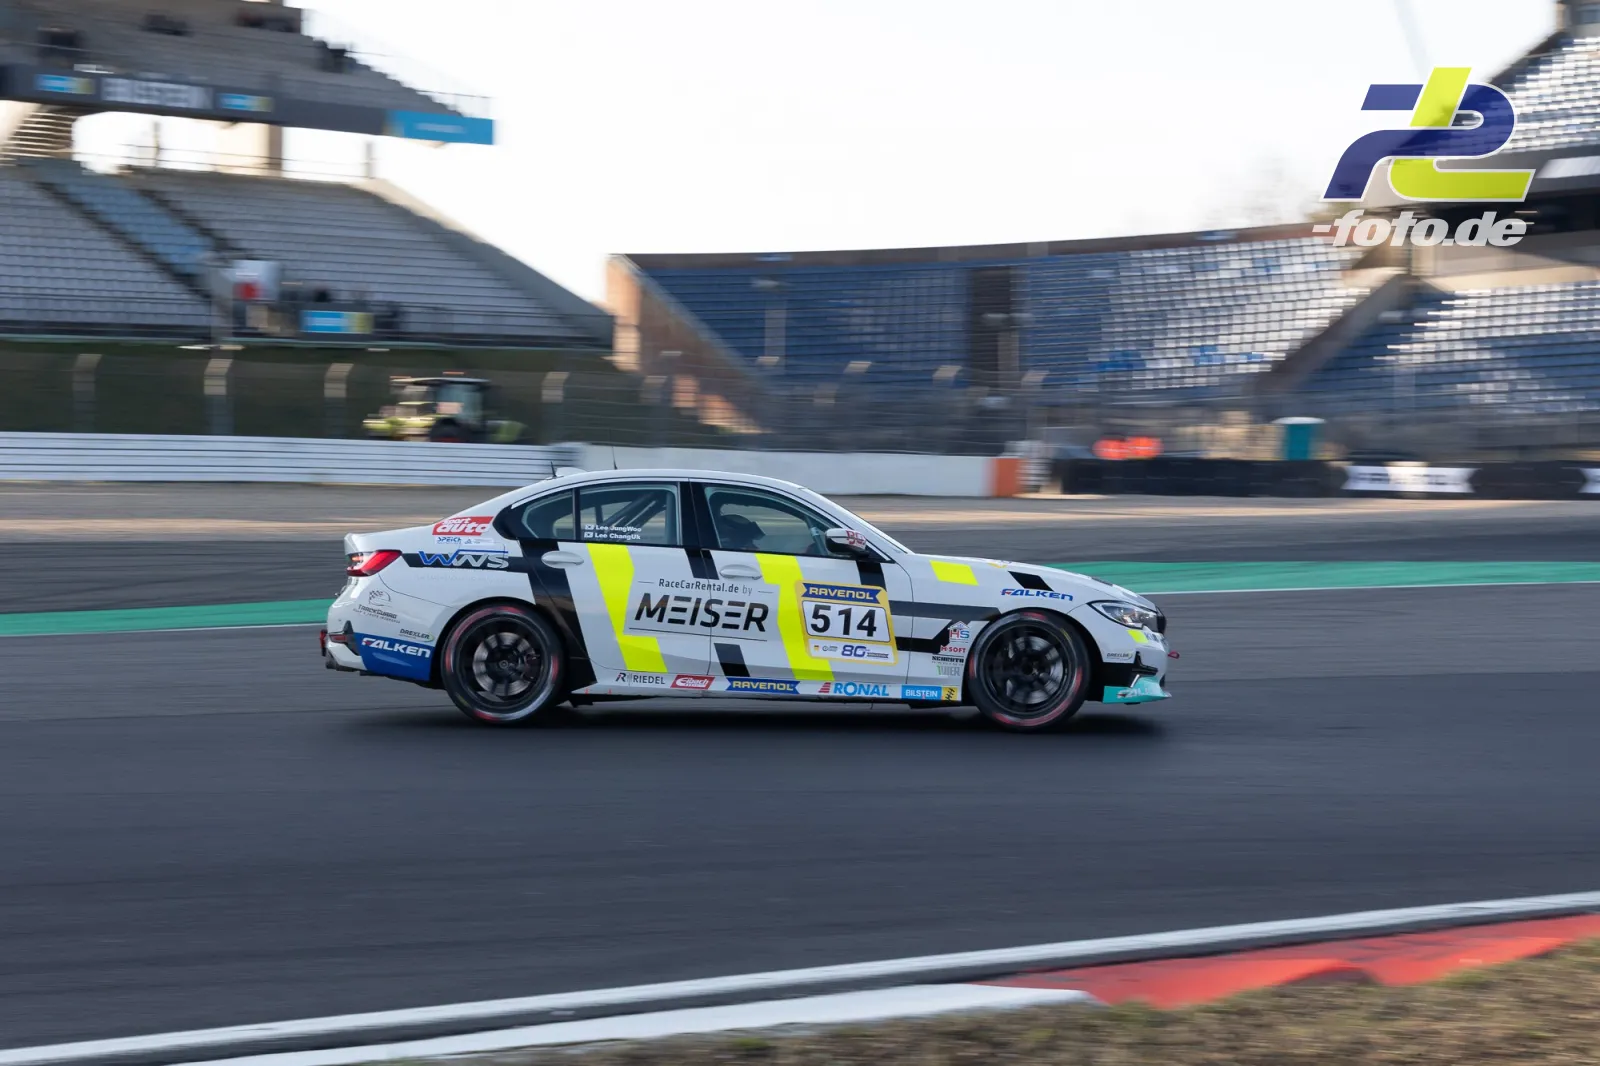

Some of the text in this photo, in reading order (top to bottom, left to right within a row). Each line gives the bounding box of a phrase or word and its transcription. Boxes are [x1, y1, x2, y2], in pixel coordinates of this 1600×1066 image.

[436, 522, 490, 533] auto
[658, 579, 753, 596] RaceCarRental.de by
[808, 587, 874, 600] RAVENOL
[1001, 588, 1074, 601] FALKEN
[634, 592, 769, 632] MEISER
[810, 604, 877, 637] 514
[400, 628, 430, 640] DREXLER
[361, 637, 431, 658] FALKEN
[633, 674, 666, 685] RIEDEL
[732, 681, 794, 691] RAVENOL
[833, 682, 890, 696] RONAL
[905, 689, 938, 698] BILSTEIN
